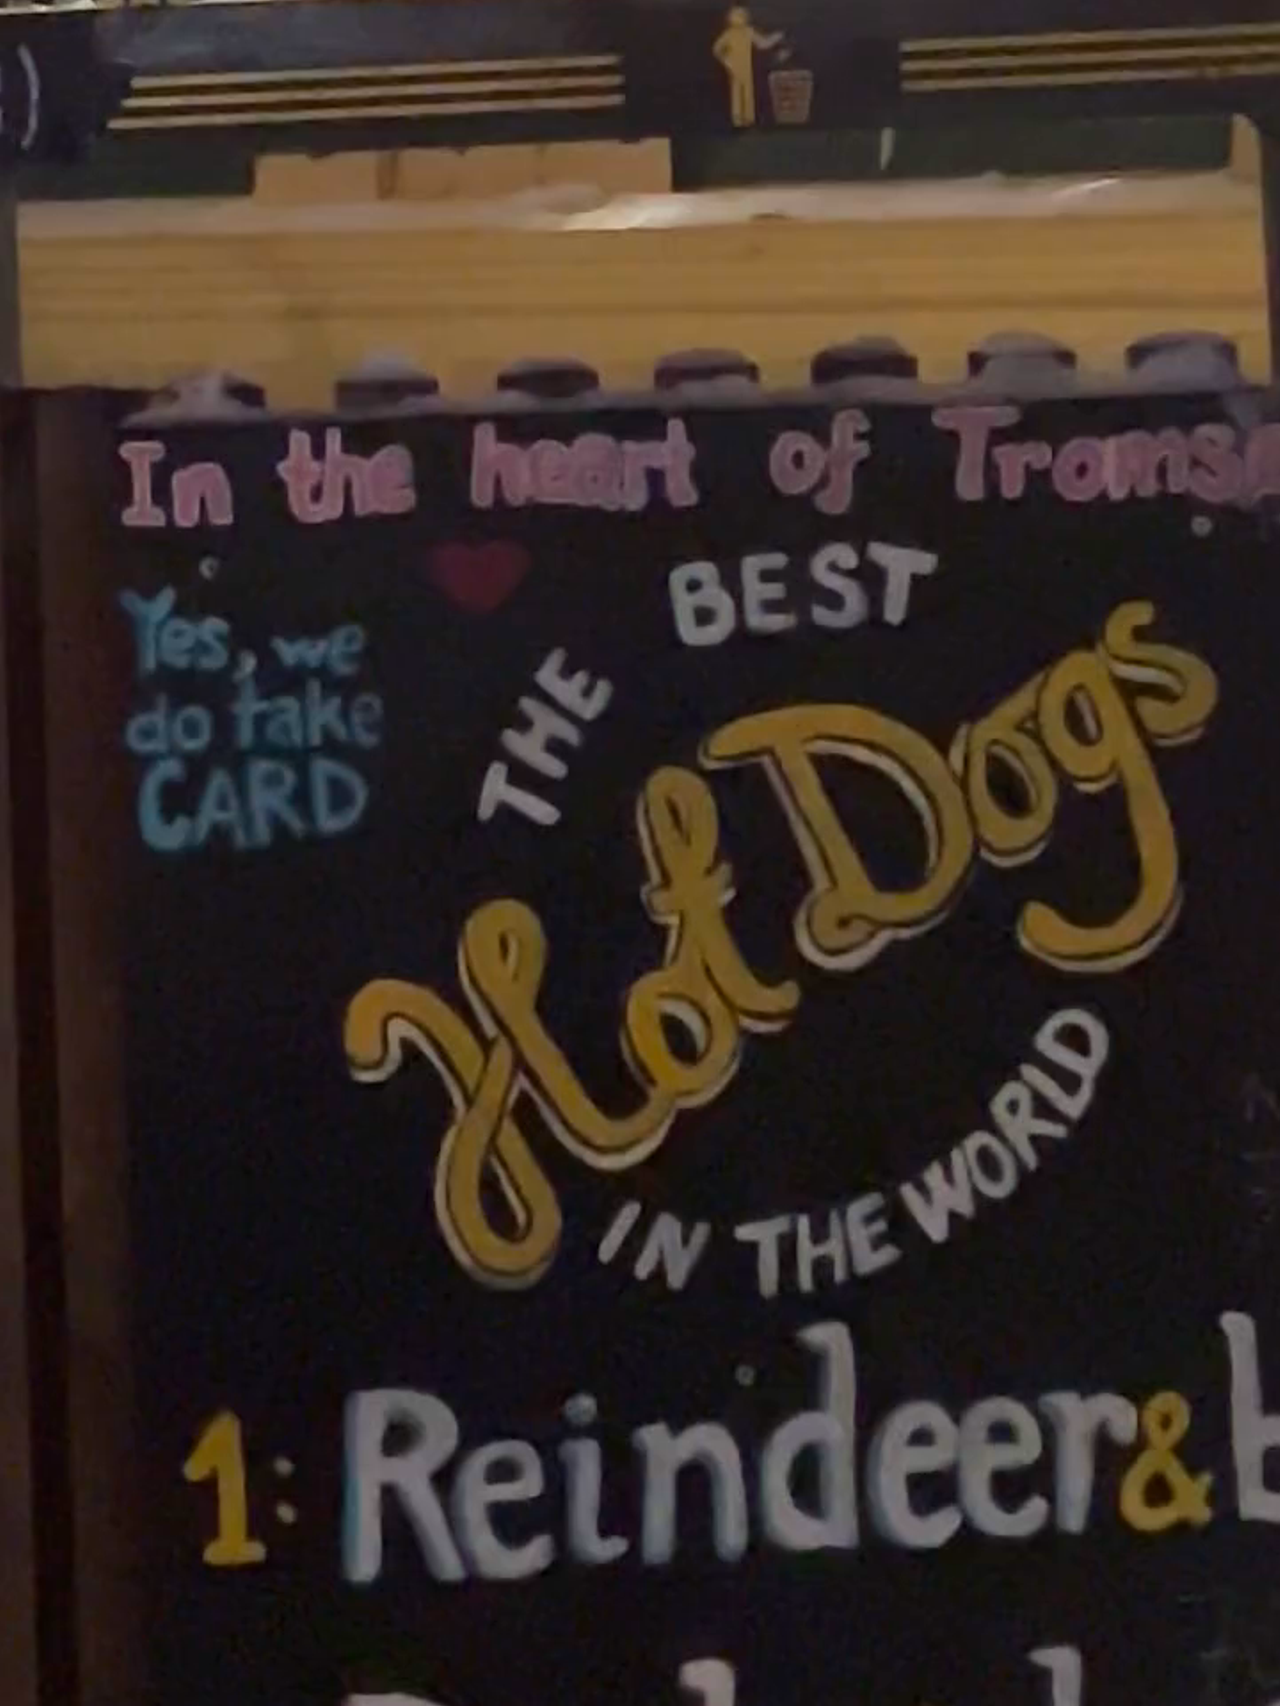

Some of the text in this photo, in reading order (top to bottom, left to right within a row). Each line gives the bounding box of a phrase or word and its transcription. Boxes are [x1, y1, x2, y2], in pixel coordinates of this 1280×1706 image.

[118, 440, 234, 528] In
[276, 427, 416, 524] the
[470, 417, 699, 512] heart
[769, 408, 872, 516] of
[272, 623, 366, 675] we
[669, 541, 938, 647] BEST
[125, 670, 383, 756] do take
[476, 646, 614, 827] THE
[136, 757, 370, 853] CARD
[596, 1005, 1112, 1301] IN THE WORLD
[180, 1408, 298, 1567] 1:
[342, 1320, 1135, 1584] Reindeer
[1120, 1389, 1214, 1535] &
